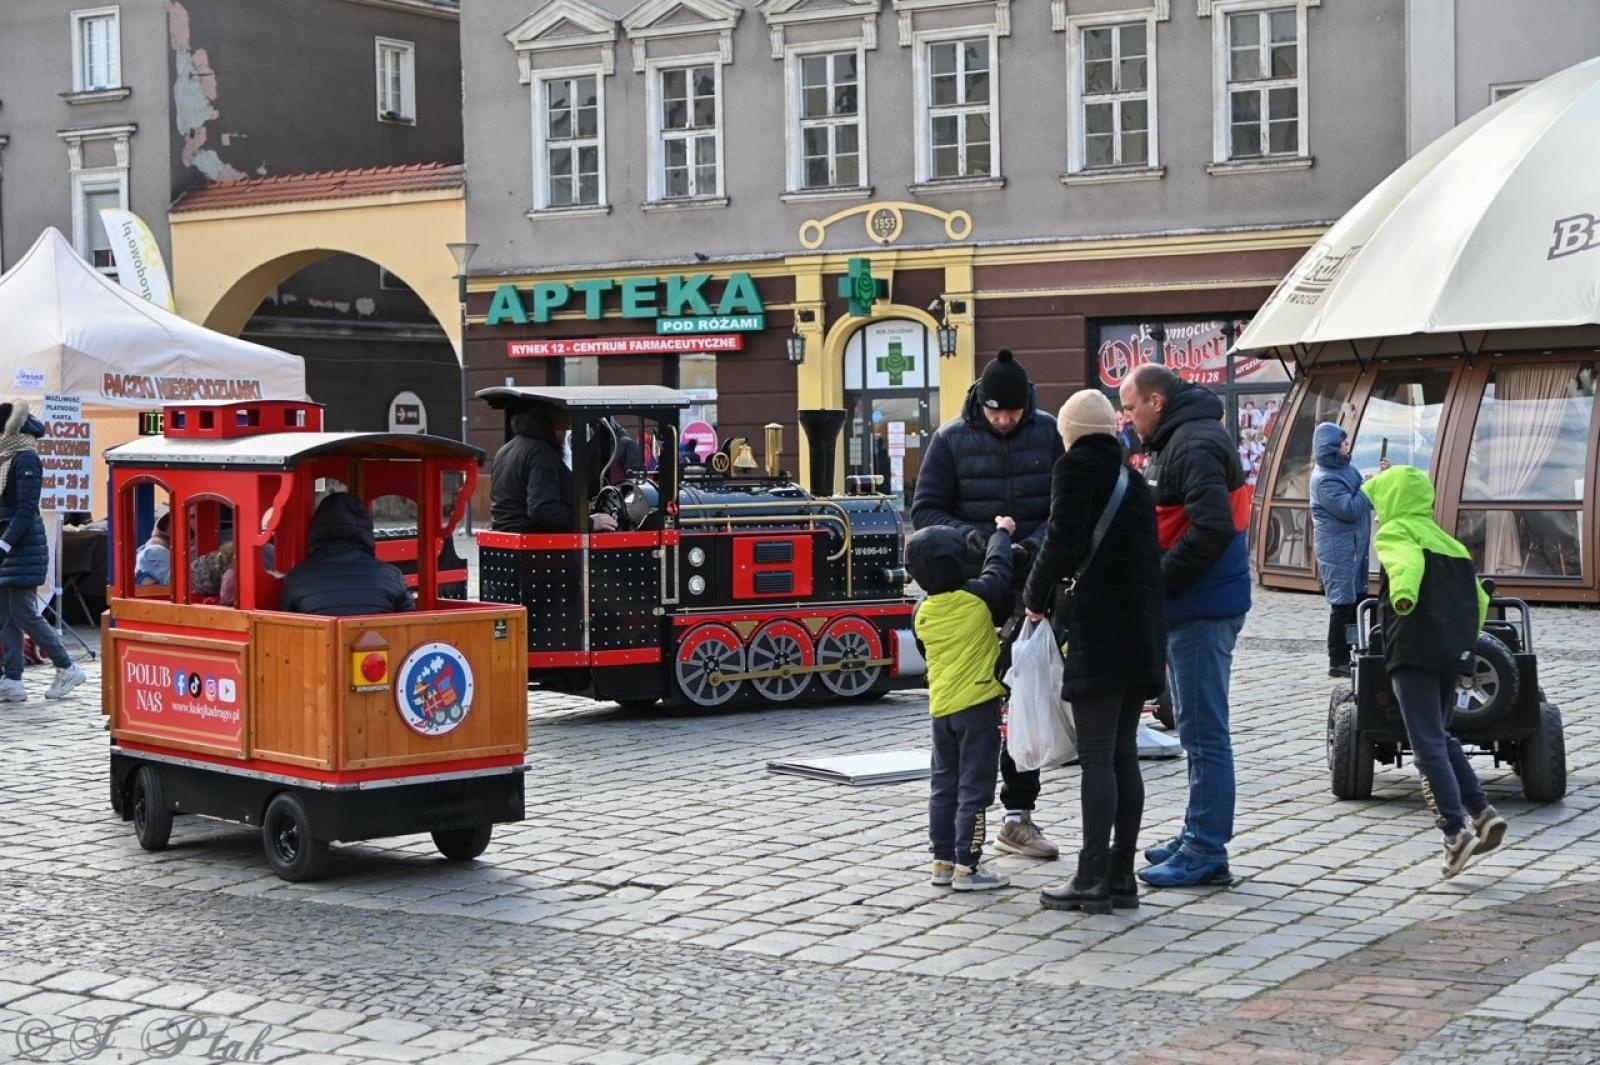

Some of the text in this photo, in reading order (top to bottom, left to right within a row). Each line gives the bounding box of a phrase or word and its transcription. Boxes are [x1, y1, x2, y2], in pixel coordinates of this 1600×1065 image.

[484, 272, 766, 326] APTEKA
[663, 316, 758, 332] POD RÓŻAMI
[511, 343, 549, 355] RYNEK
[551, 342, 565, 354] 12
[573, 340, 627, 352] CENTRUM
[630, 336, 737, 351] FARMACEUTYCZNE
[1207, 371, 1219, 383] 28
[43, 421, 91, 439] ACZKI
[127, 662, 171, 688] POLUB
[136, 690, 163, 713] NAS
